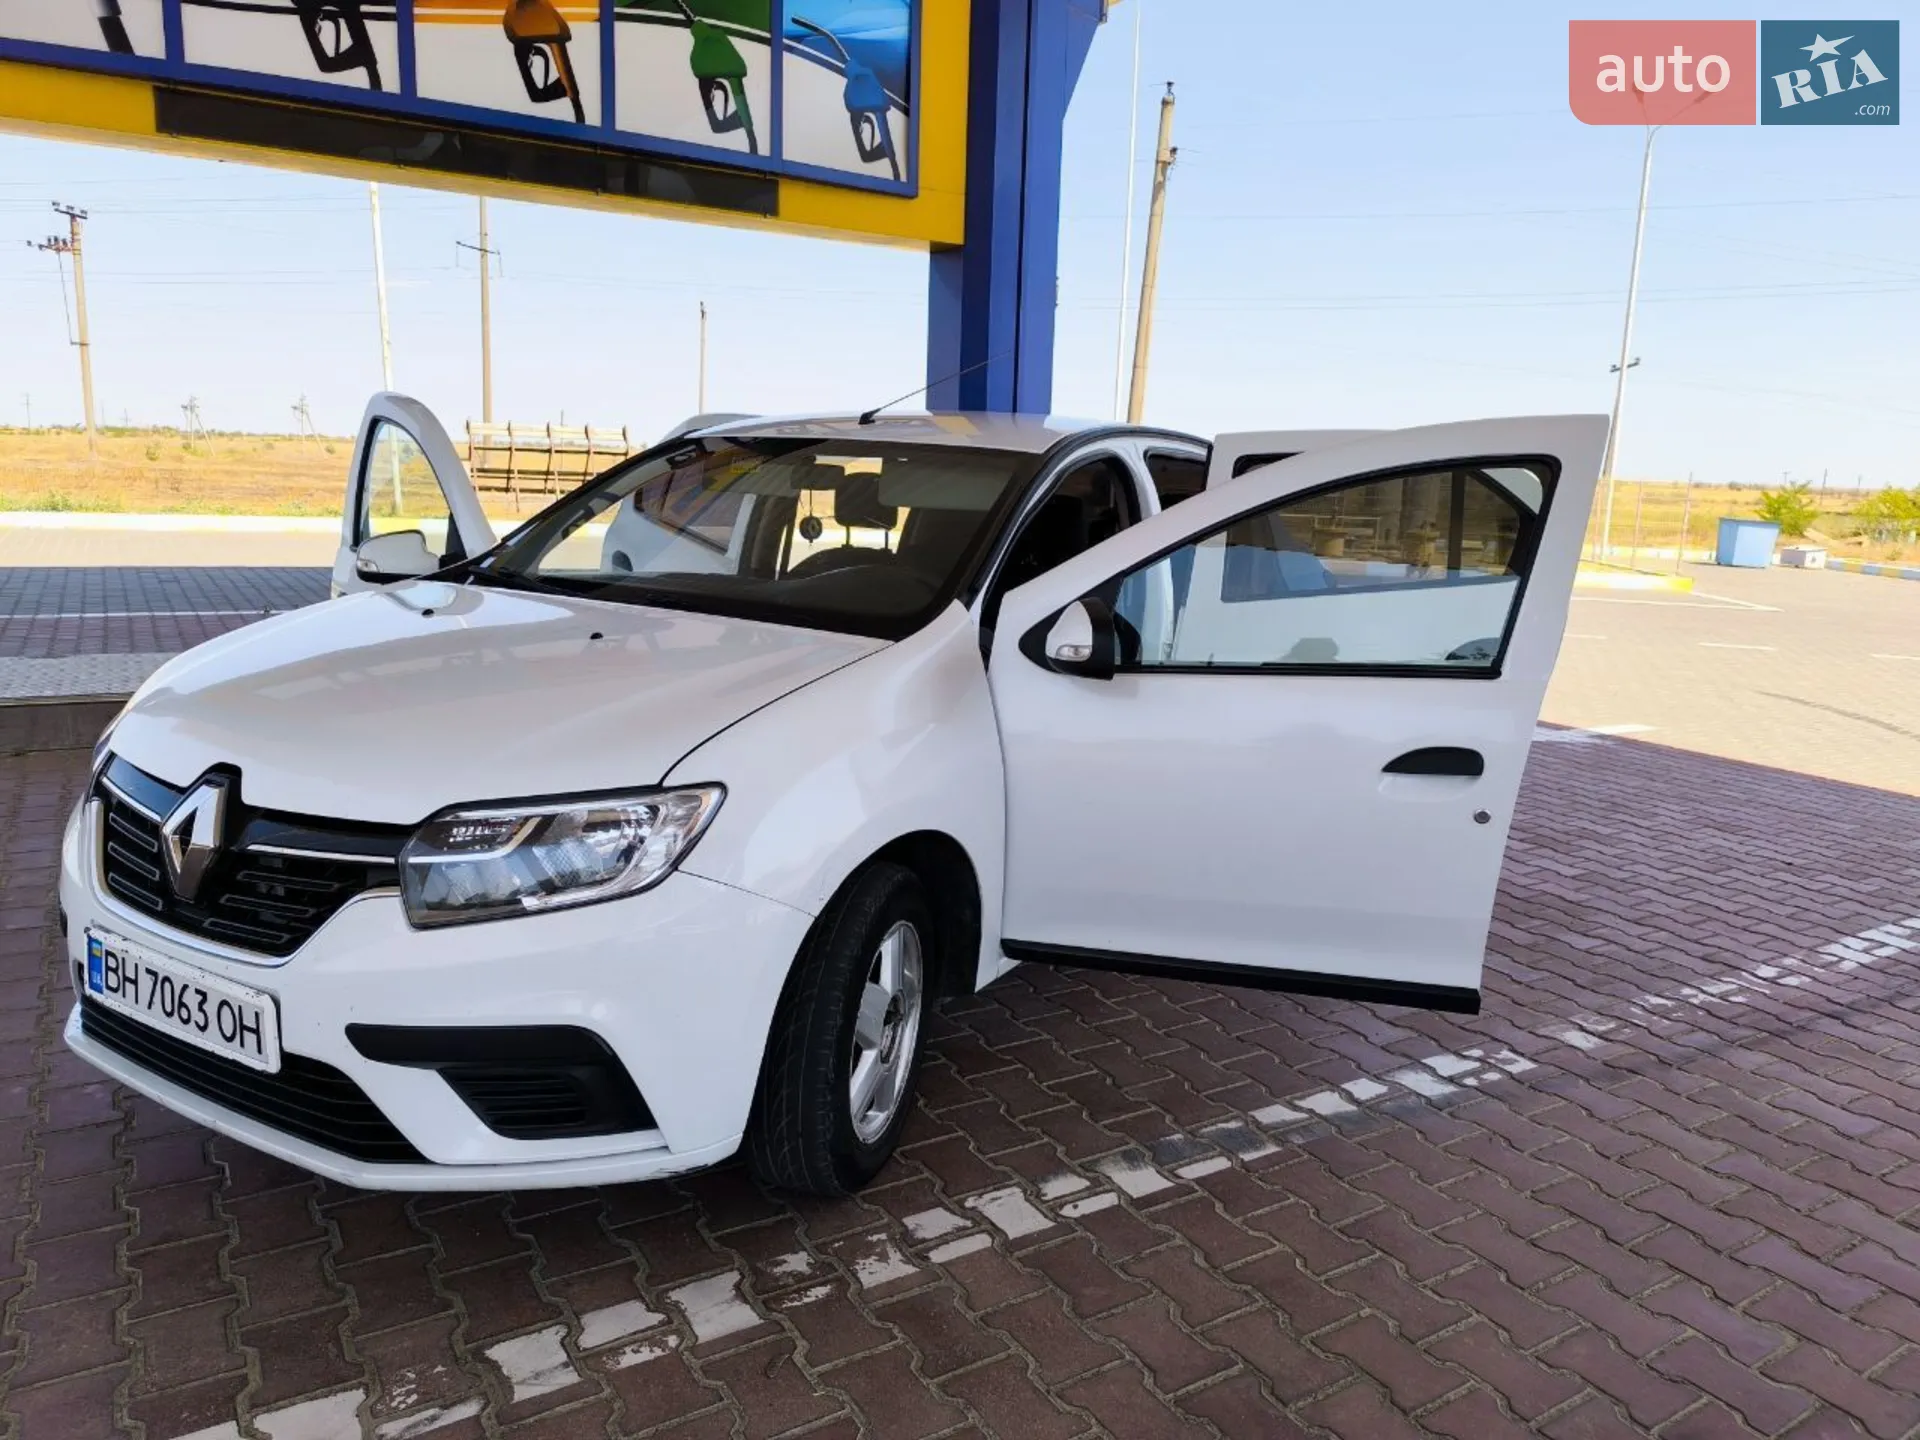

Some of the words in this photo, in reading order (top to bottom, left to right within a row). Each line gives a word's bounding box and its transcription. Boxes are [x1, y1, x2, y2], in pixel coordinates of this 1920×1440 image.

[104, 948, 139, 1005] BH
[145, 967, 209, 1033] 7063
[216, 999, 263, 1055] OH
